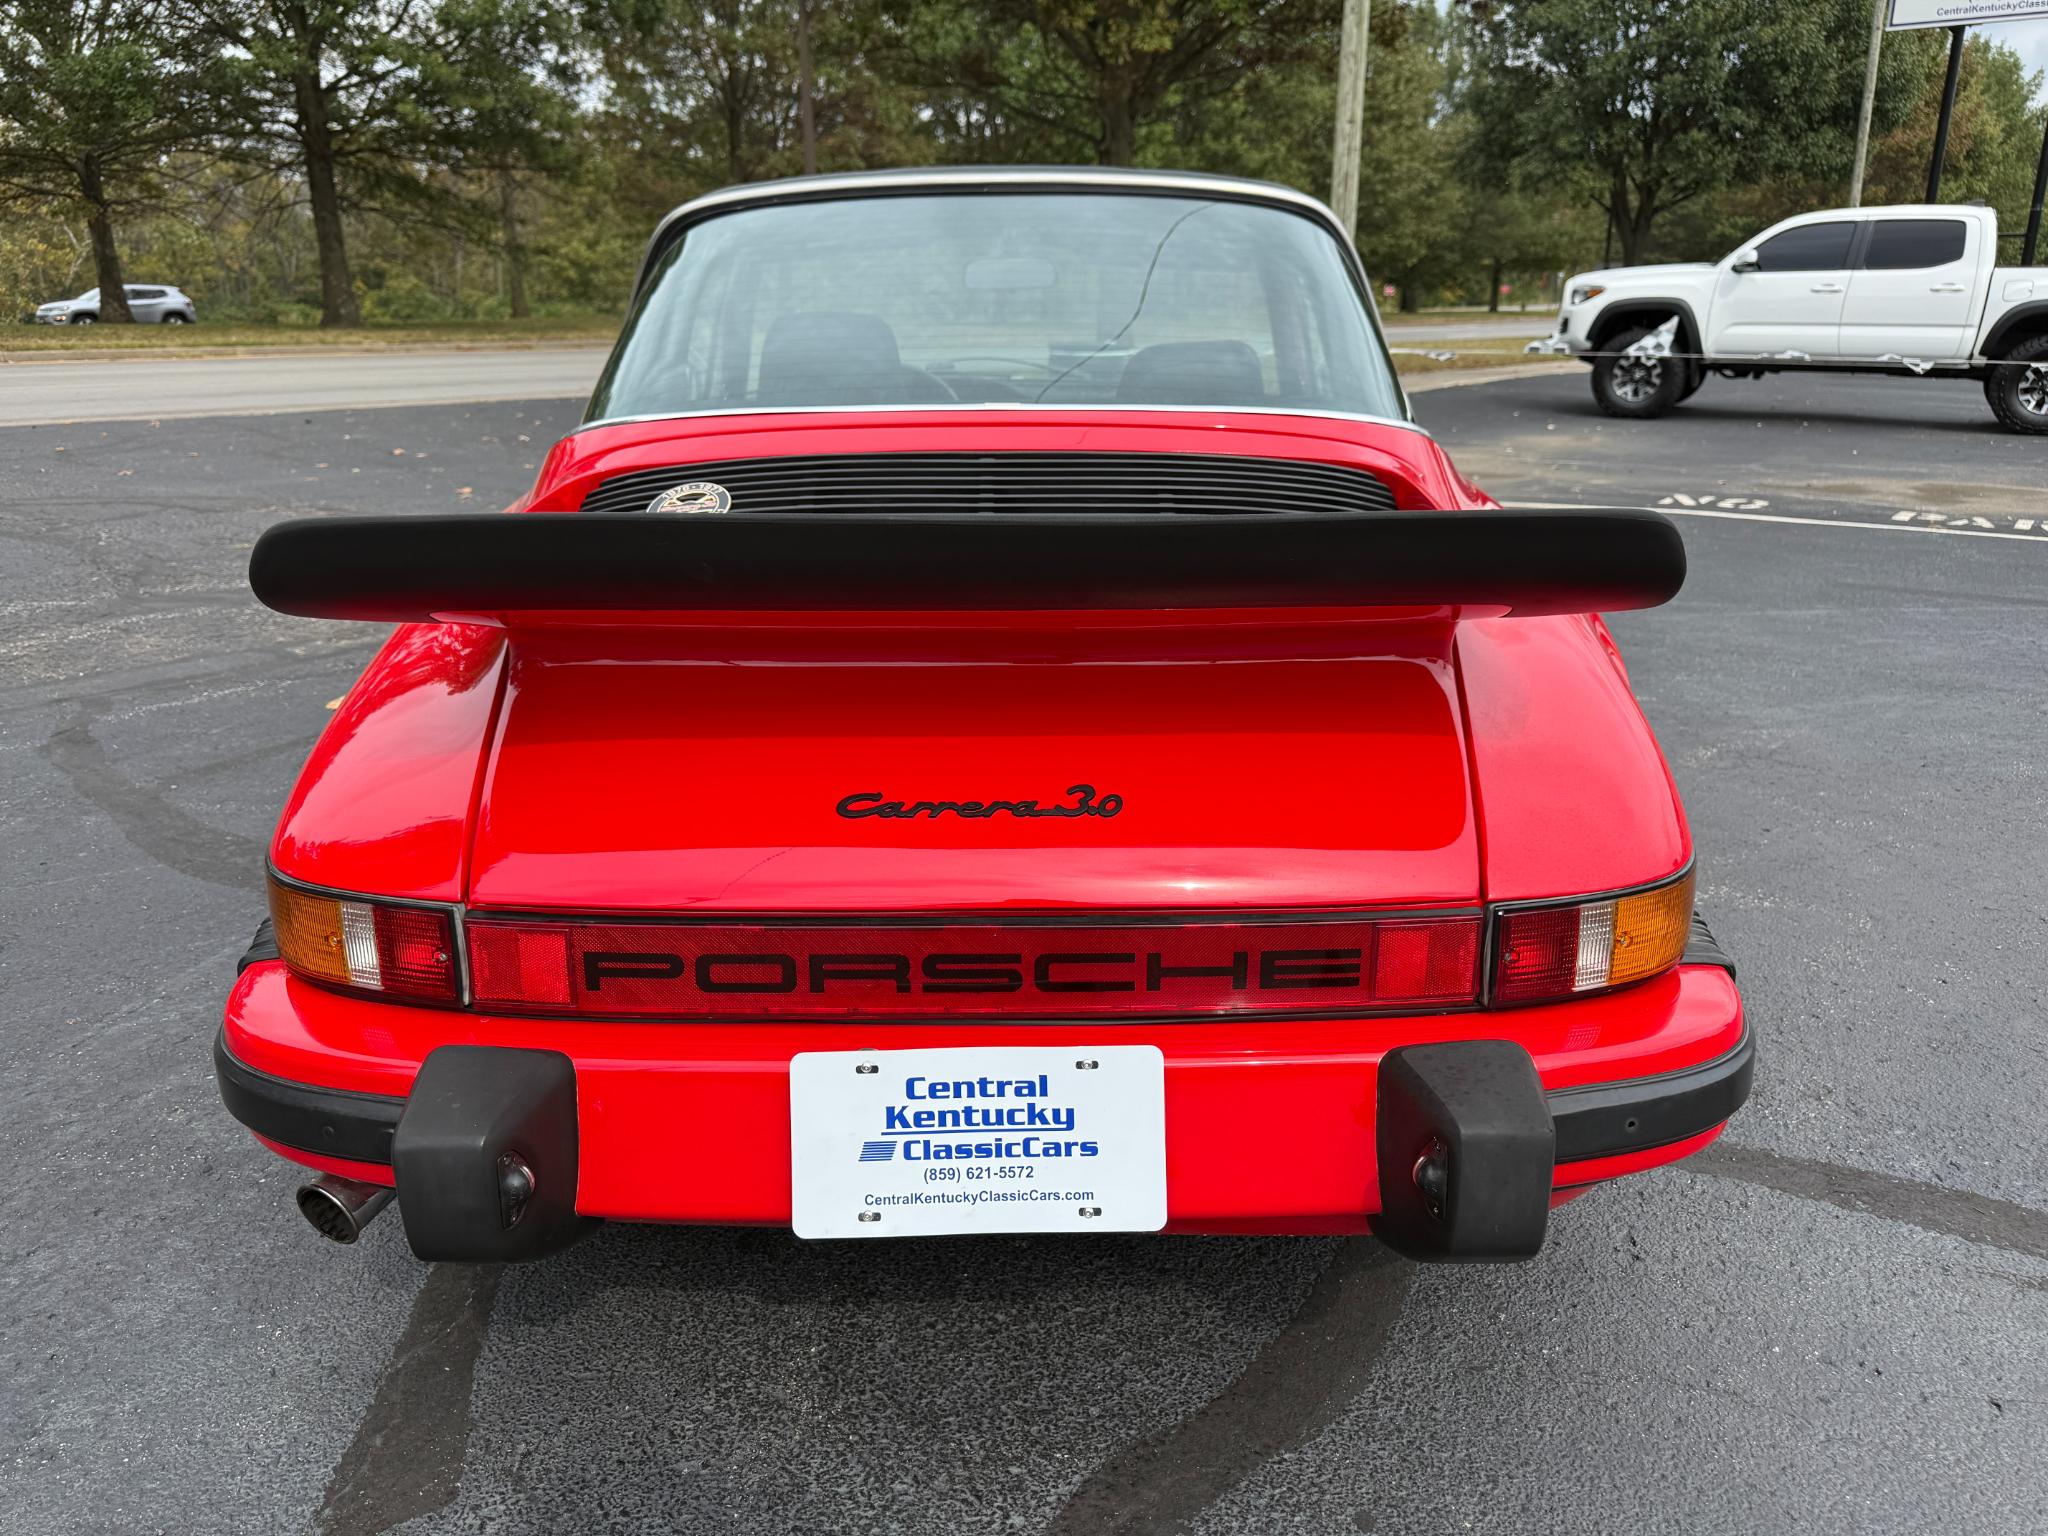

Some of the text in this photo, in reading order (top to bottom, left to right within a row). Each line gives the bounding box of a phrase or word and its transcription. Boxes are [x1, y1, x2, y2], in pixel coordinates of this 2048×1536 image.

[1656, 493, 1770, 509] NO
[836, 784, 1123, 818] Carrera 3.0
[583, 948, 1362, 993] PORSCHE
[905, 1074, 1049, 1101] Central
[885, 1102, 1075, 1131] Kentucky
[903, 1136, 1099, 1161] ClassicCars
[923, 1165, 1035, 1184] (859) 621-5572
[864, 1188, 1095, 1206] CentralKentuckyClassicCars.com
